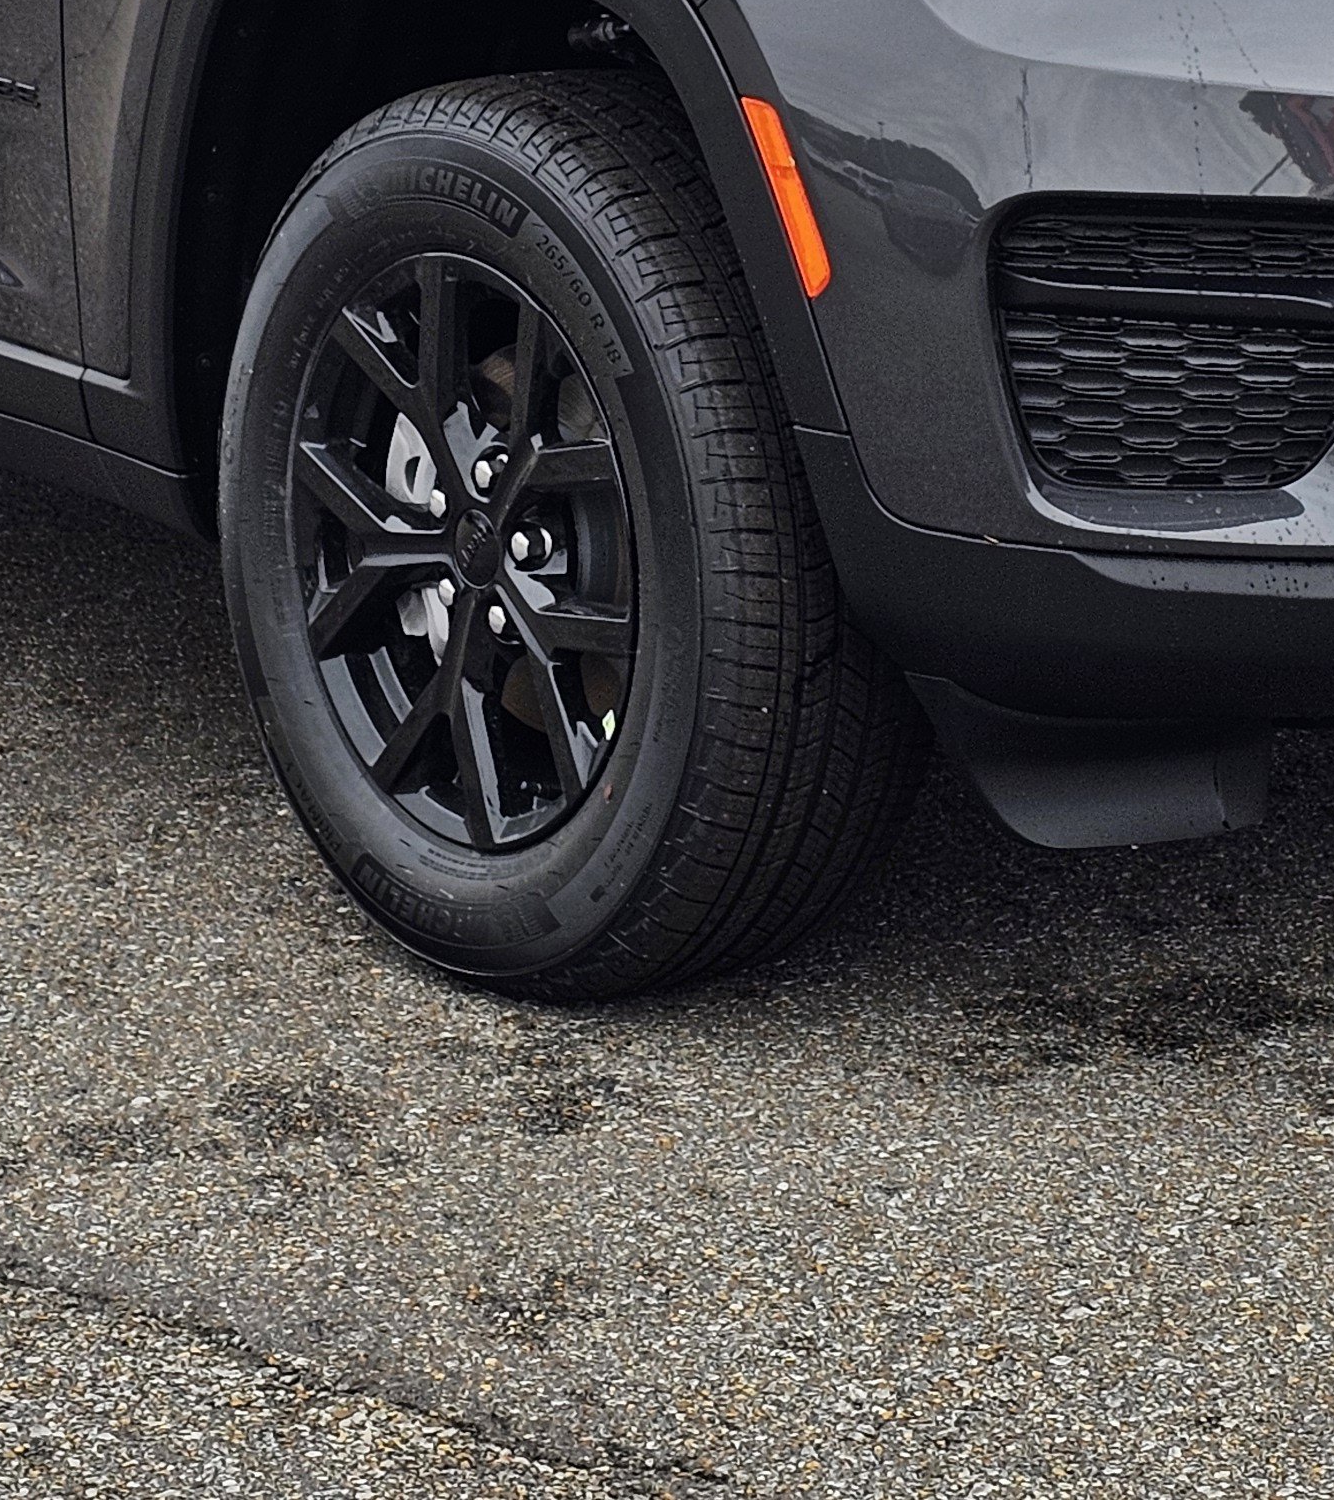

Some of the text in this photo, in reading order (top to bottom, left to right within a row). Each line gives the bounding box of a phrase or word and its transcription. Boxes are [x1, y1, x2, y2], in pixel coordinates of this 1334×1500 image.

[389, 164, 520, 230] MICHELIN
[534, 233, 622, 365] 265/60 R 18
